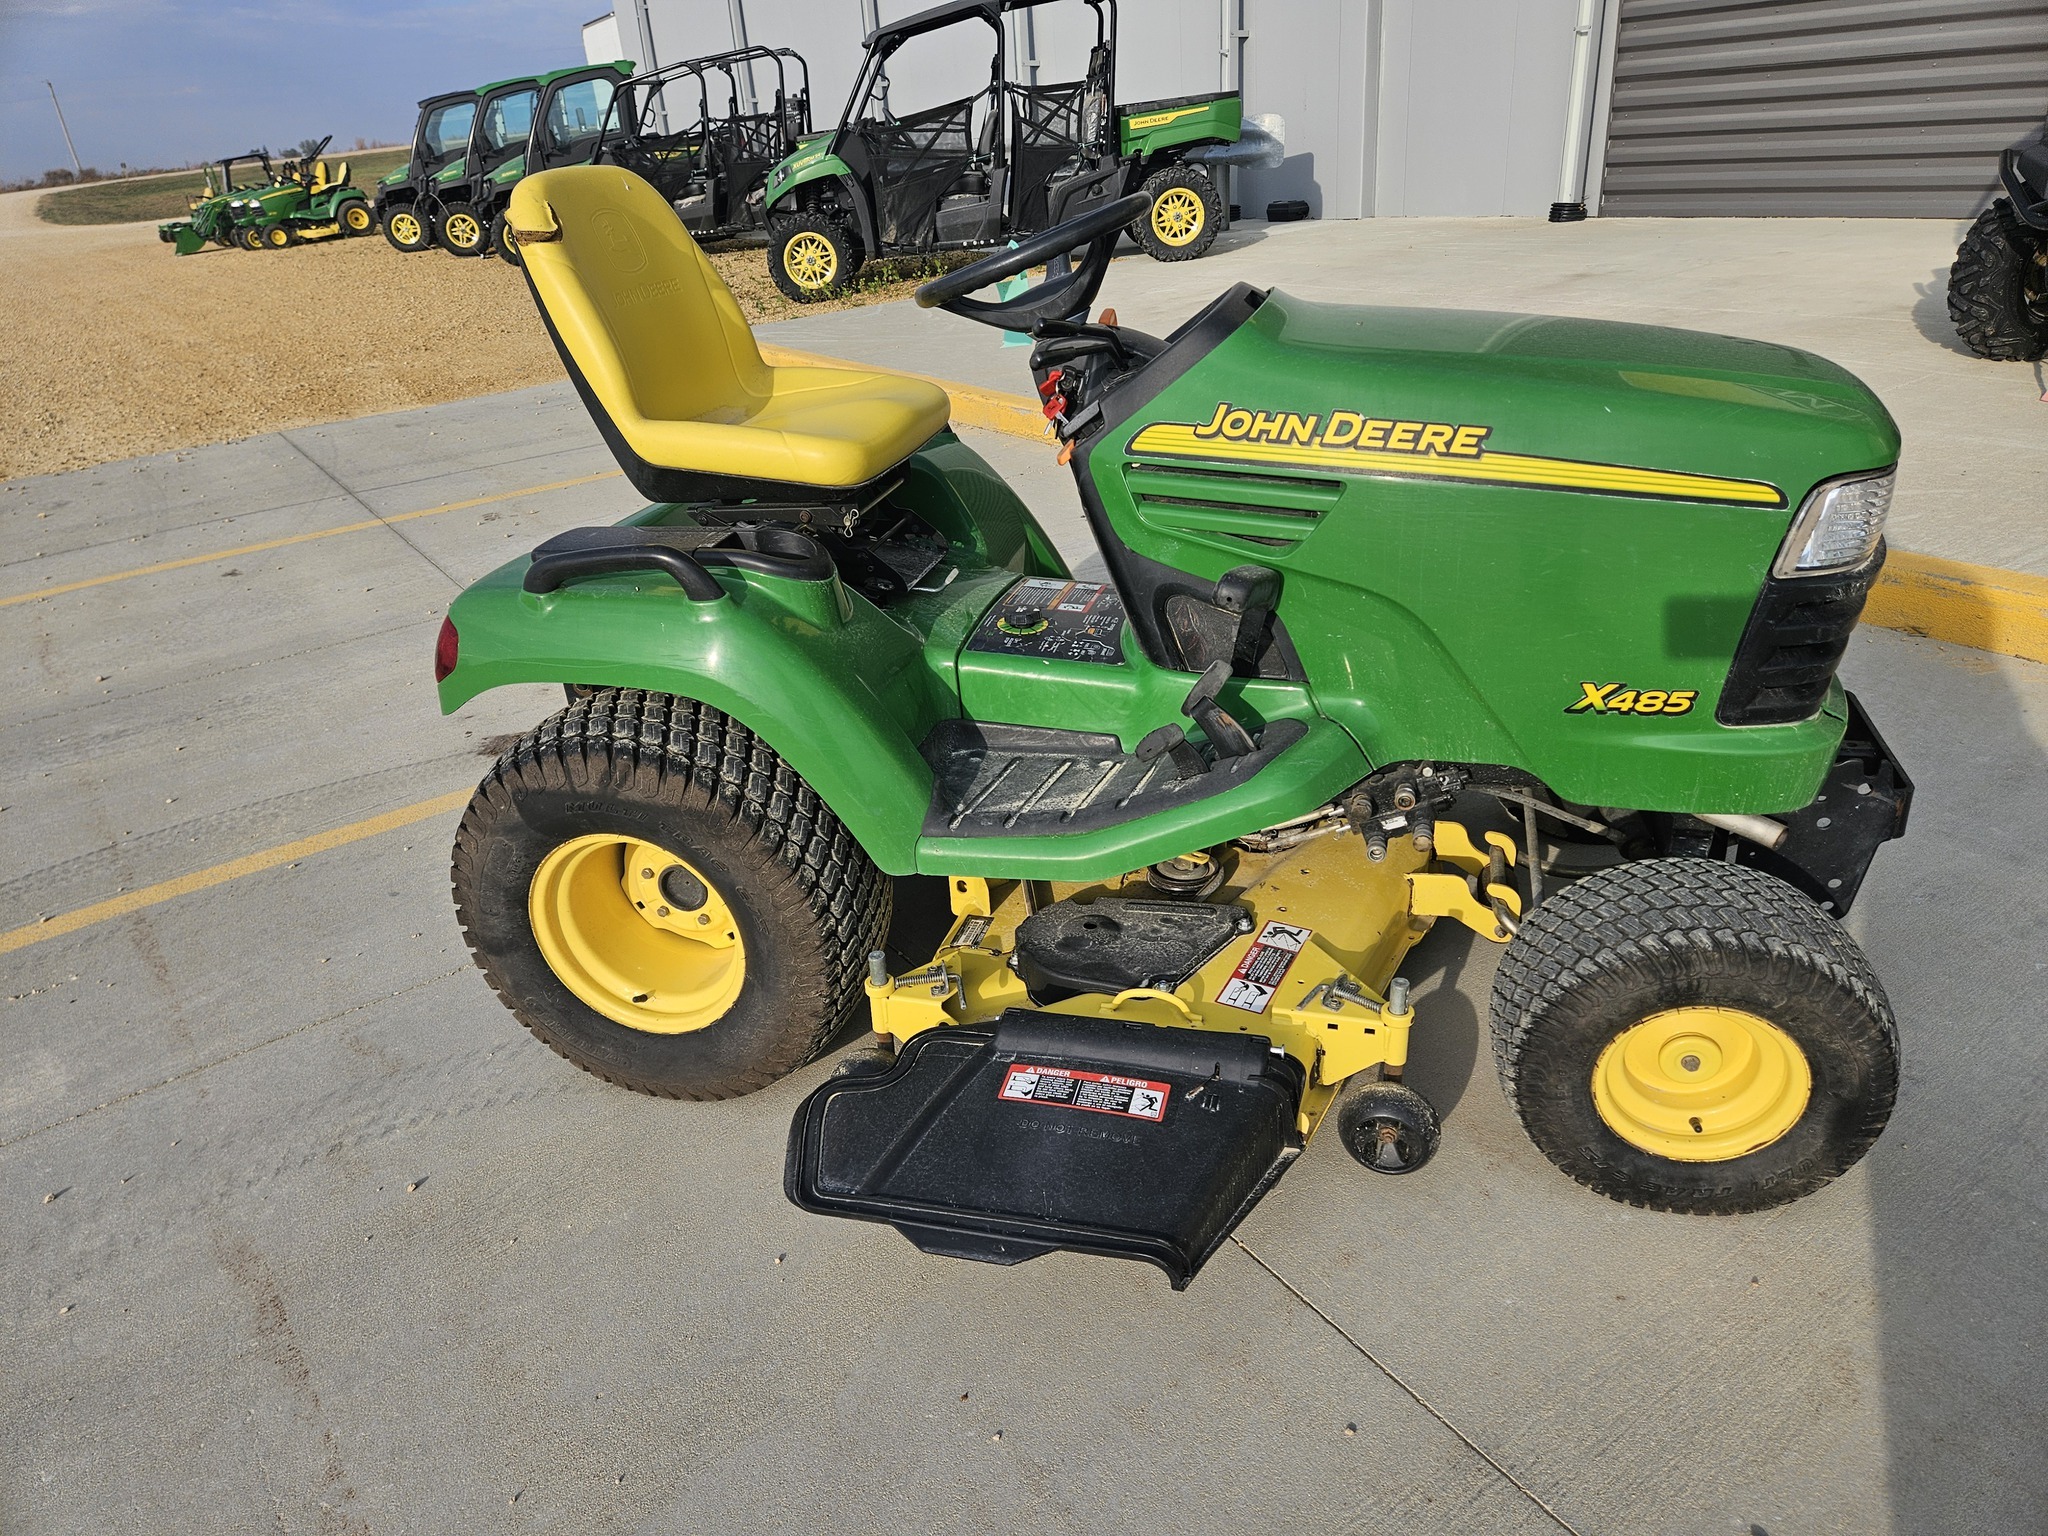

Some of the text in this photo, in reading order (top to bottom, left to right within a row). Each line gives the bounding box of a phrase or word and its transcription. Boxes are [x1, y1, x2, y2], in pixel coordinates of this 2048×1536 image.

[1149, 116, 1169, 124] DEERE
[1194, 401, 1493, 459] JOHN DEERE
[1564, 682, 1700, 716] X485
[564, 801, 649, 822] MULTI
[1240, 946, 1261, 970] DANGER
[1036, 1067, 1071, 1078] DANGER
[1110, 1077, 1148, 1089] PELIGRO
[1043, 1124, 1074, 1135] NOT
